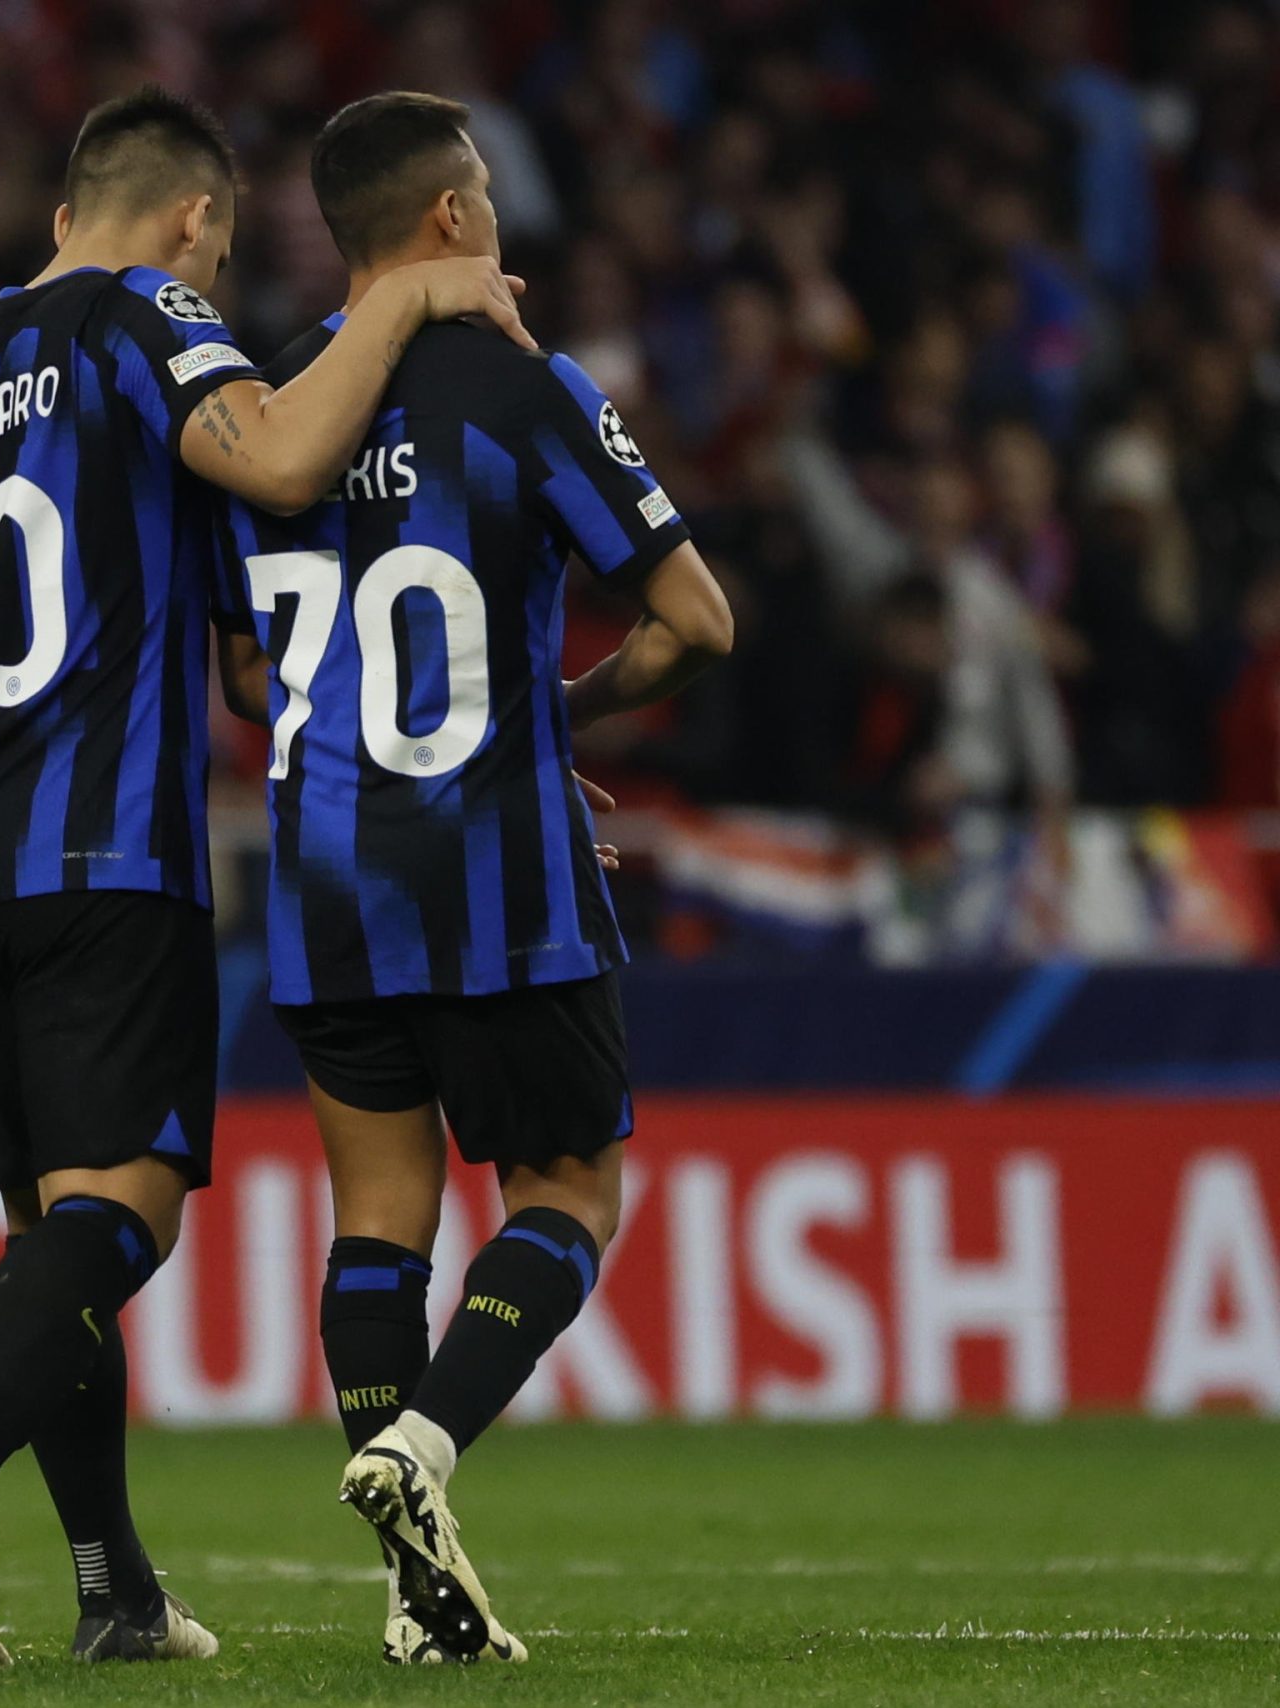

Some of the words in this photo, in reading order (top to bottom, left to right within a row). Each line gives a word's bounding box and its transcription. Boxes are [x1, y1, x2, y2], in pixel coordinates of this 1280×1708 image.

[324, 441, 418, 501] XIS
[244, 545, 490, 780] 70
[467, 1295, 521, 1327] INTER
[340, 1385, 400, 1412] INTER
